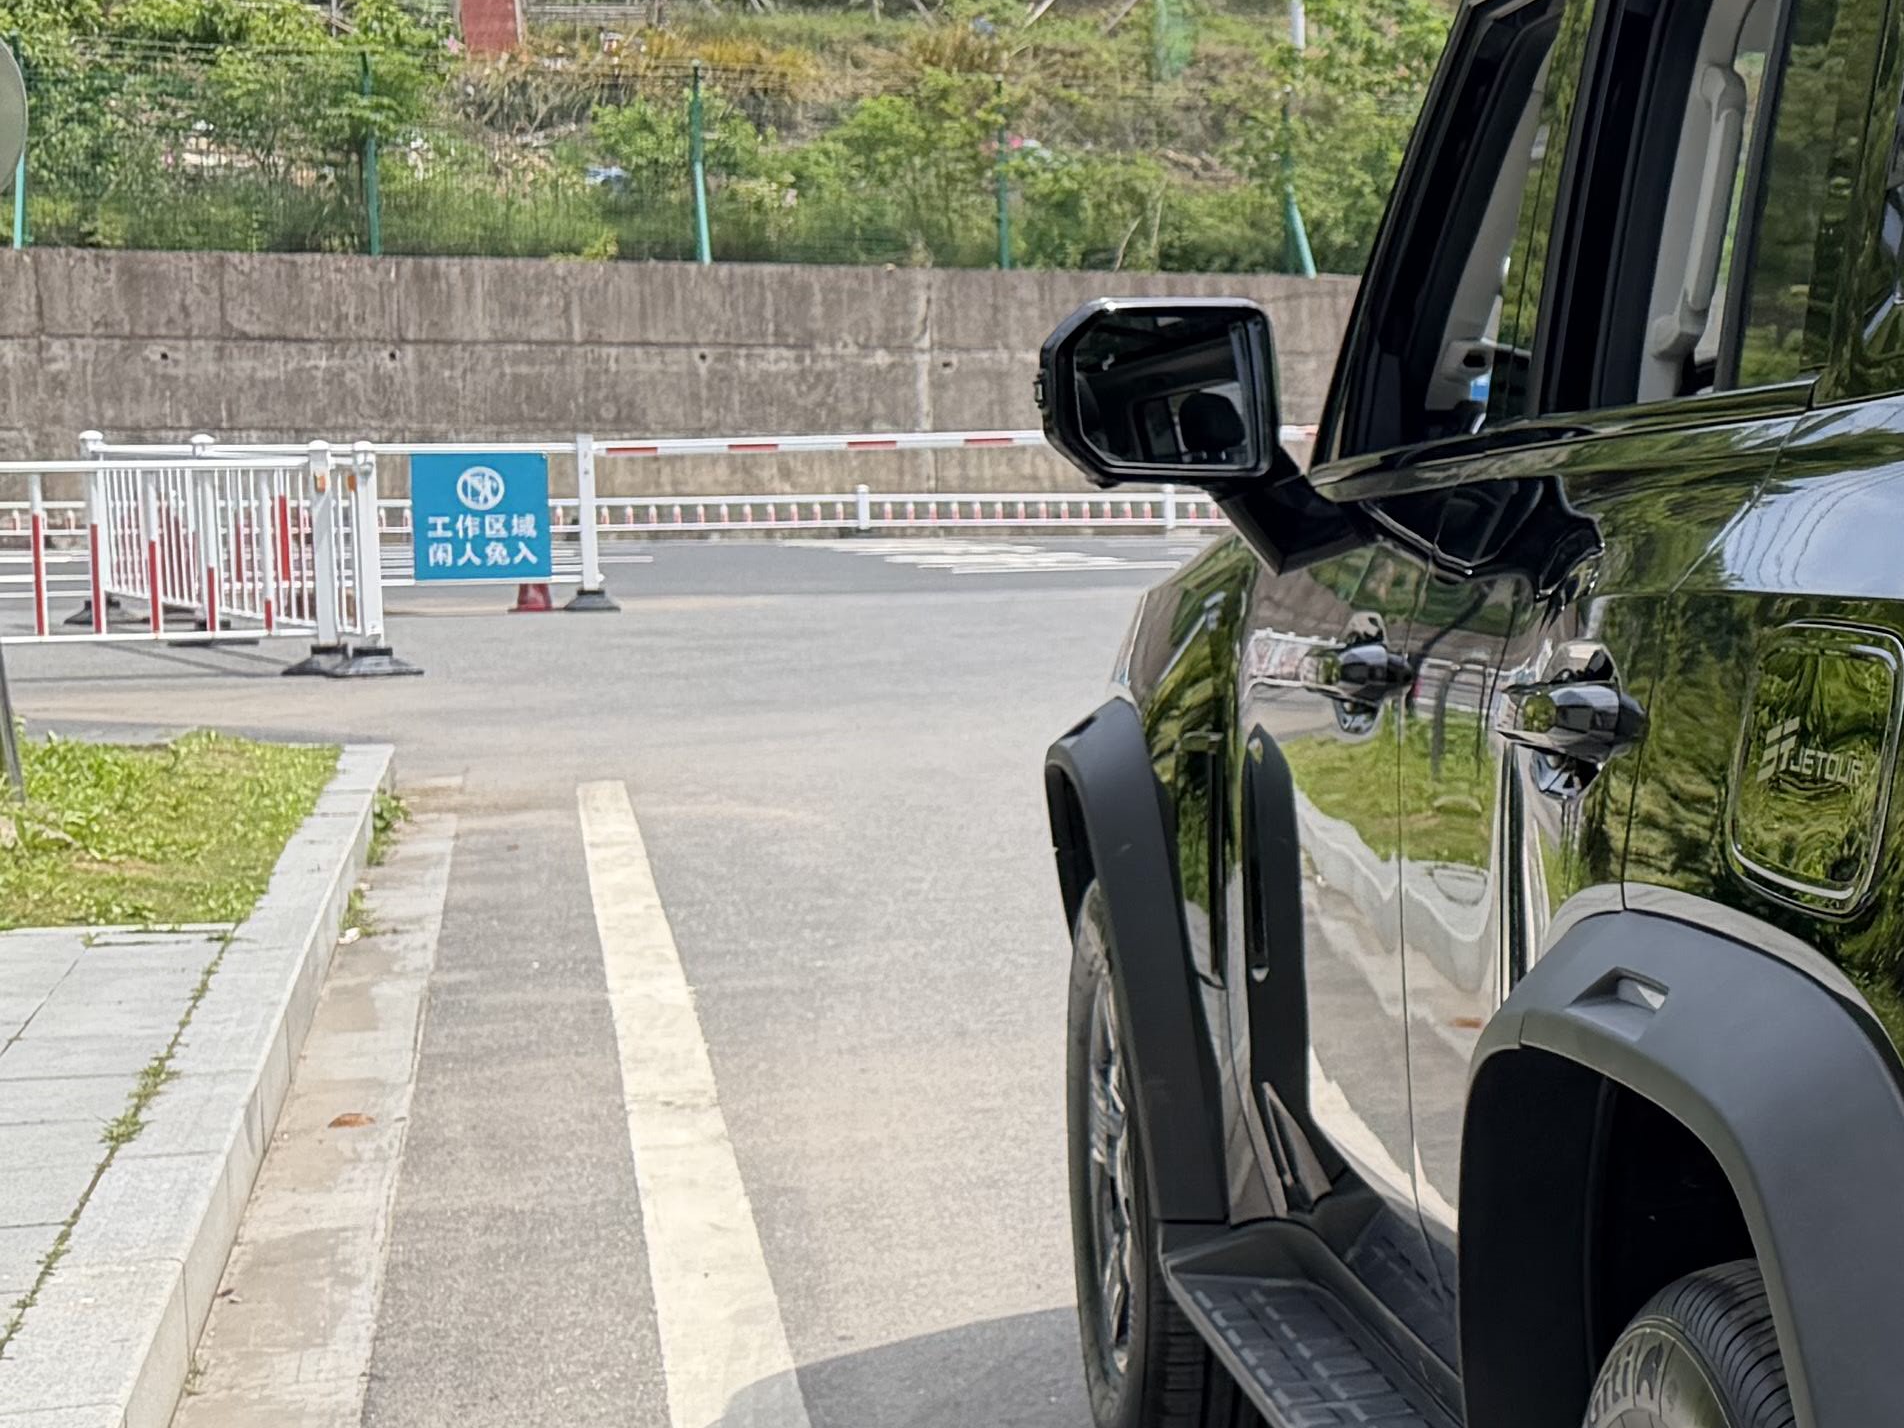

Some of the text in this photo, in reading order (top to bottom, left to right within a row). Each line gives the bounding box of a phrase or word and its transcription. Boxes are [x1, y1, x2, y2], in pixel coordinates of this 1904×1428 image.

[427, 513, 538, 539] 工作区域
[428, 541, 539, 567] 闲人免入
